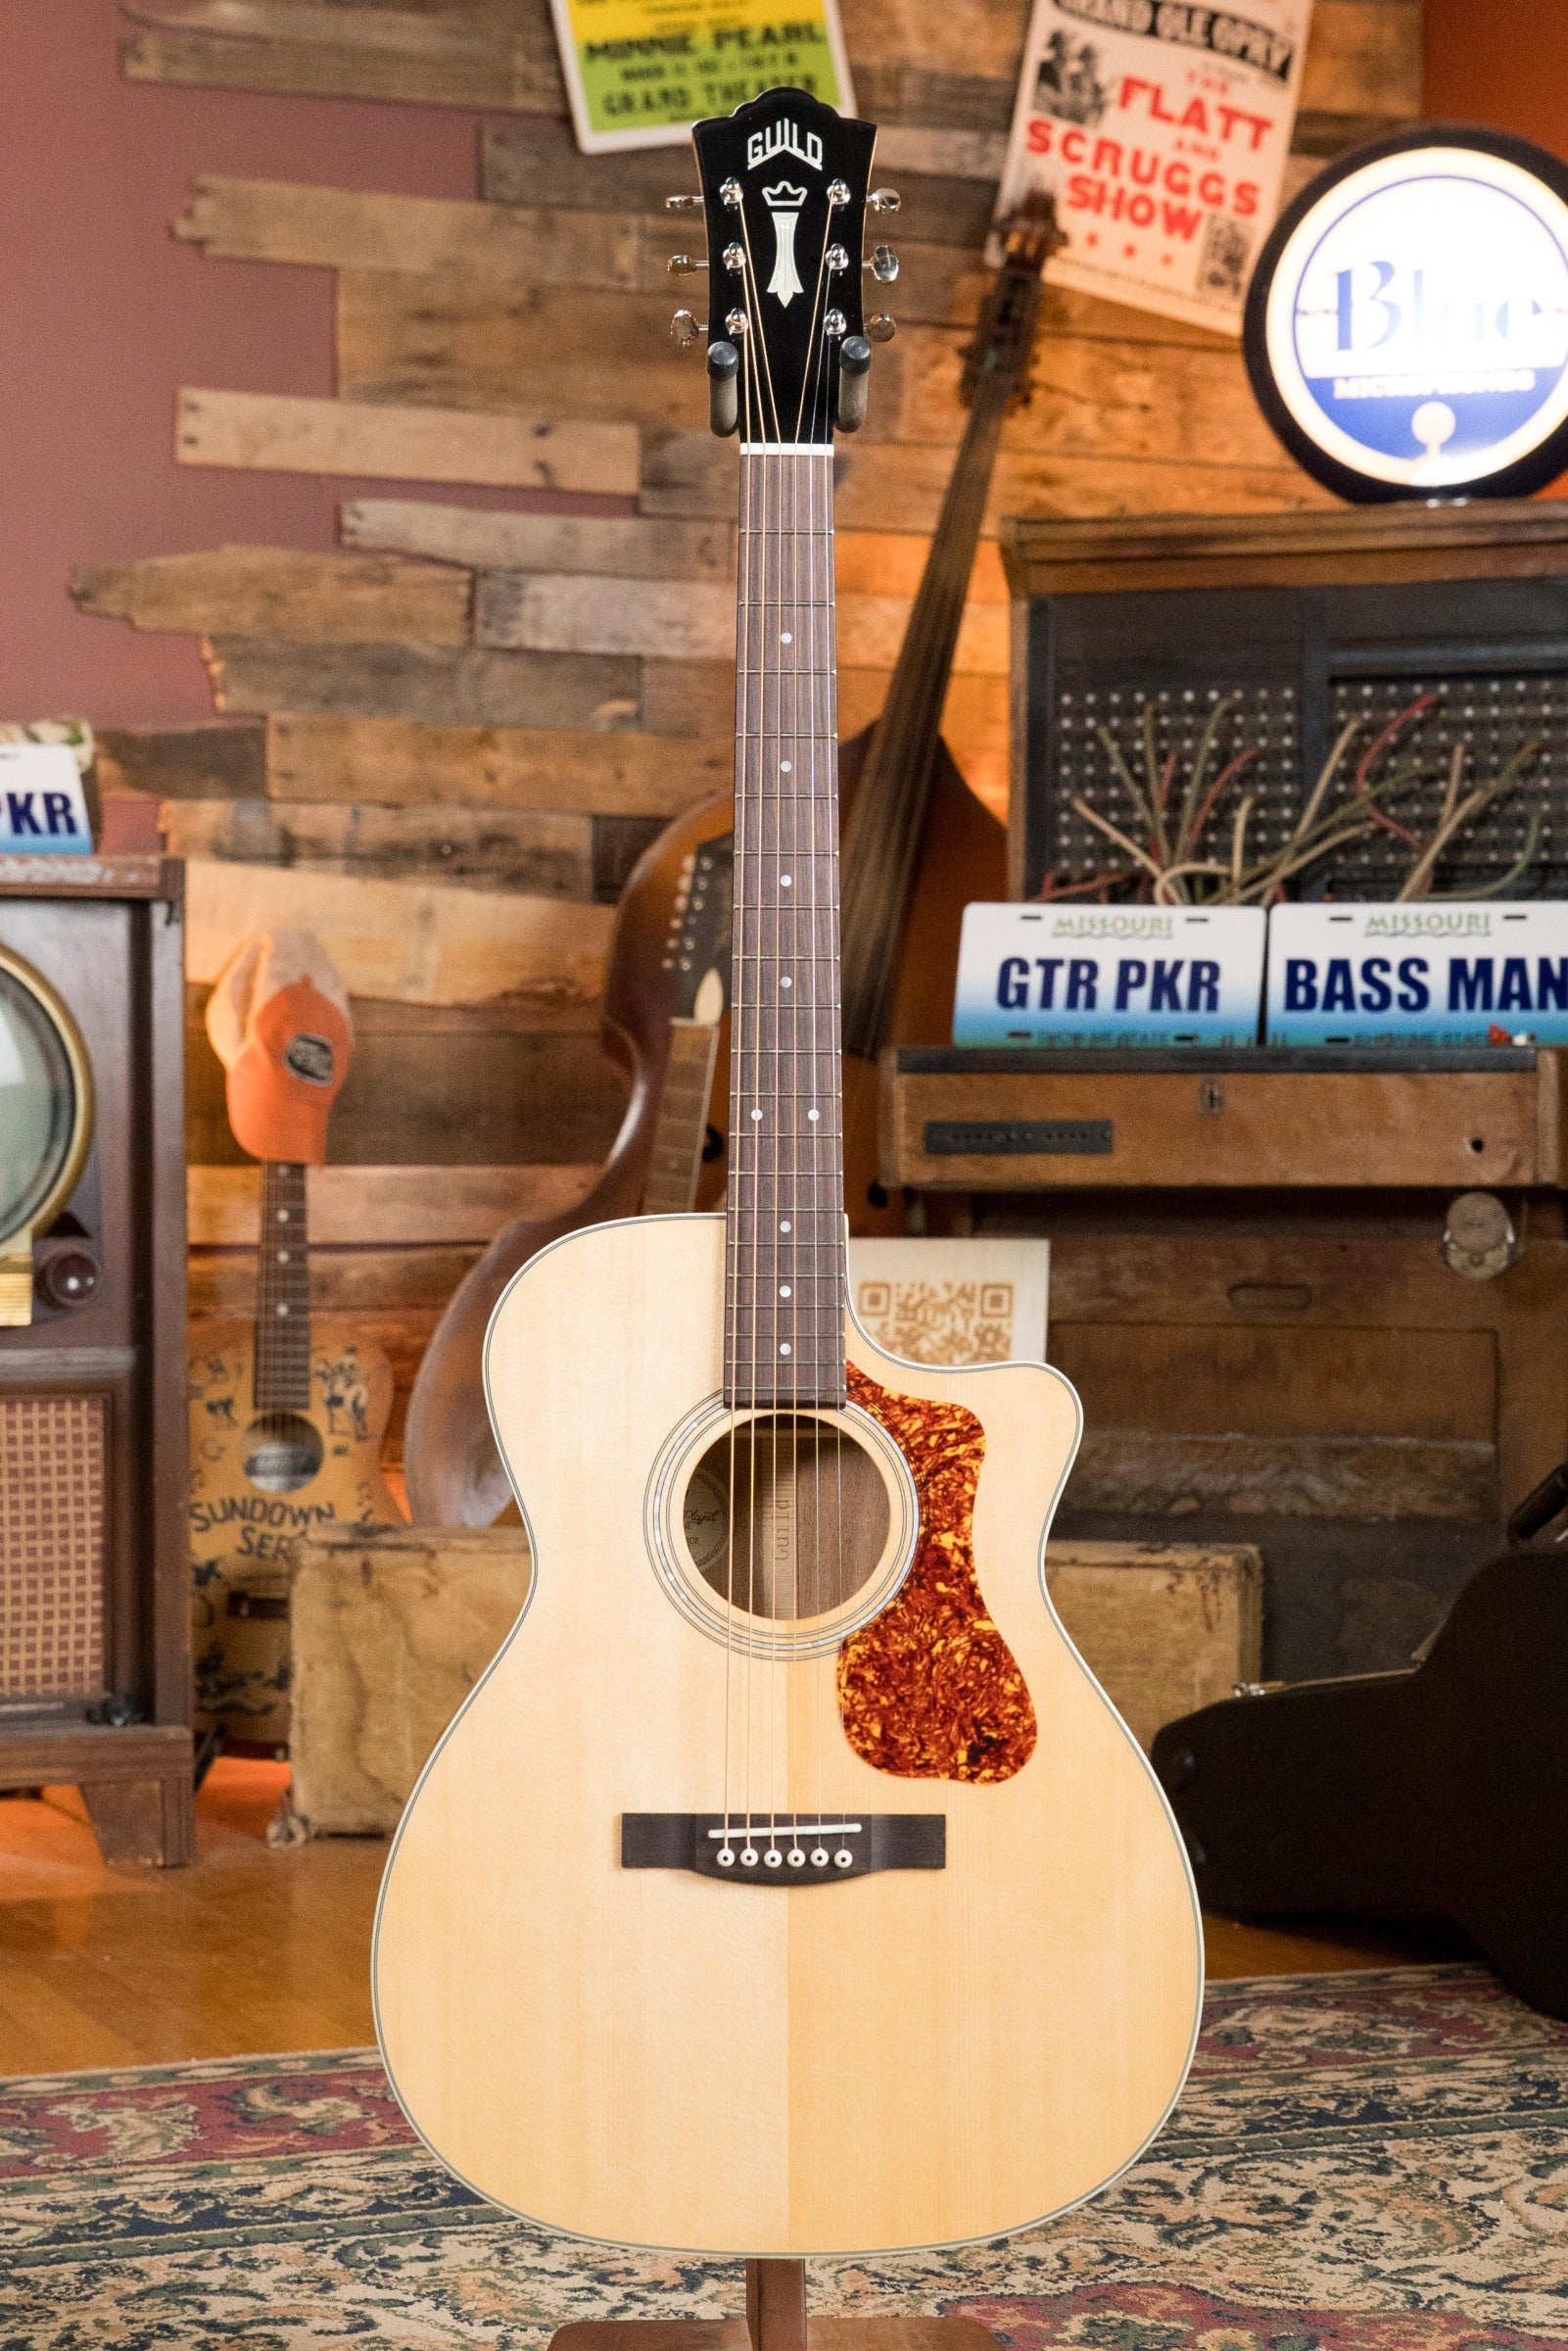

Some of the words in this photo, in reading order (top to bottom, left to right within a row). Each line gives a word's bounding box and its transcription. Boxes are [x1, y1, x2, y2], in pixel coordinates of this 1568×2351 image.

[712, 23, 823, 48] PEARL
[603, 87, 691, 116] GRAND
[1119, 73, 1273, 150] FLATT
[747, 119, 823, 170] GUILD
[1026, 118, 1259, 216] SCRUGGS
[1068, 174, 1203, 241] SHOW
[1334, 260, 1544, 351] Blue
[0, 792, 78, 836] KR
[1053, 915, 1174, 932] MISSOURI
[1365, 912, 1492, 932] MISSOURI
[996, 957, 1099, 1011] GTR
[1115, 958, 1220, 1013] PKR
[1284, 957, 1431, 1013] BASS
[1448, 957, 1568, 1012] MAN
[190, 1495, 337, 1533] SUNDOWN
